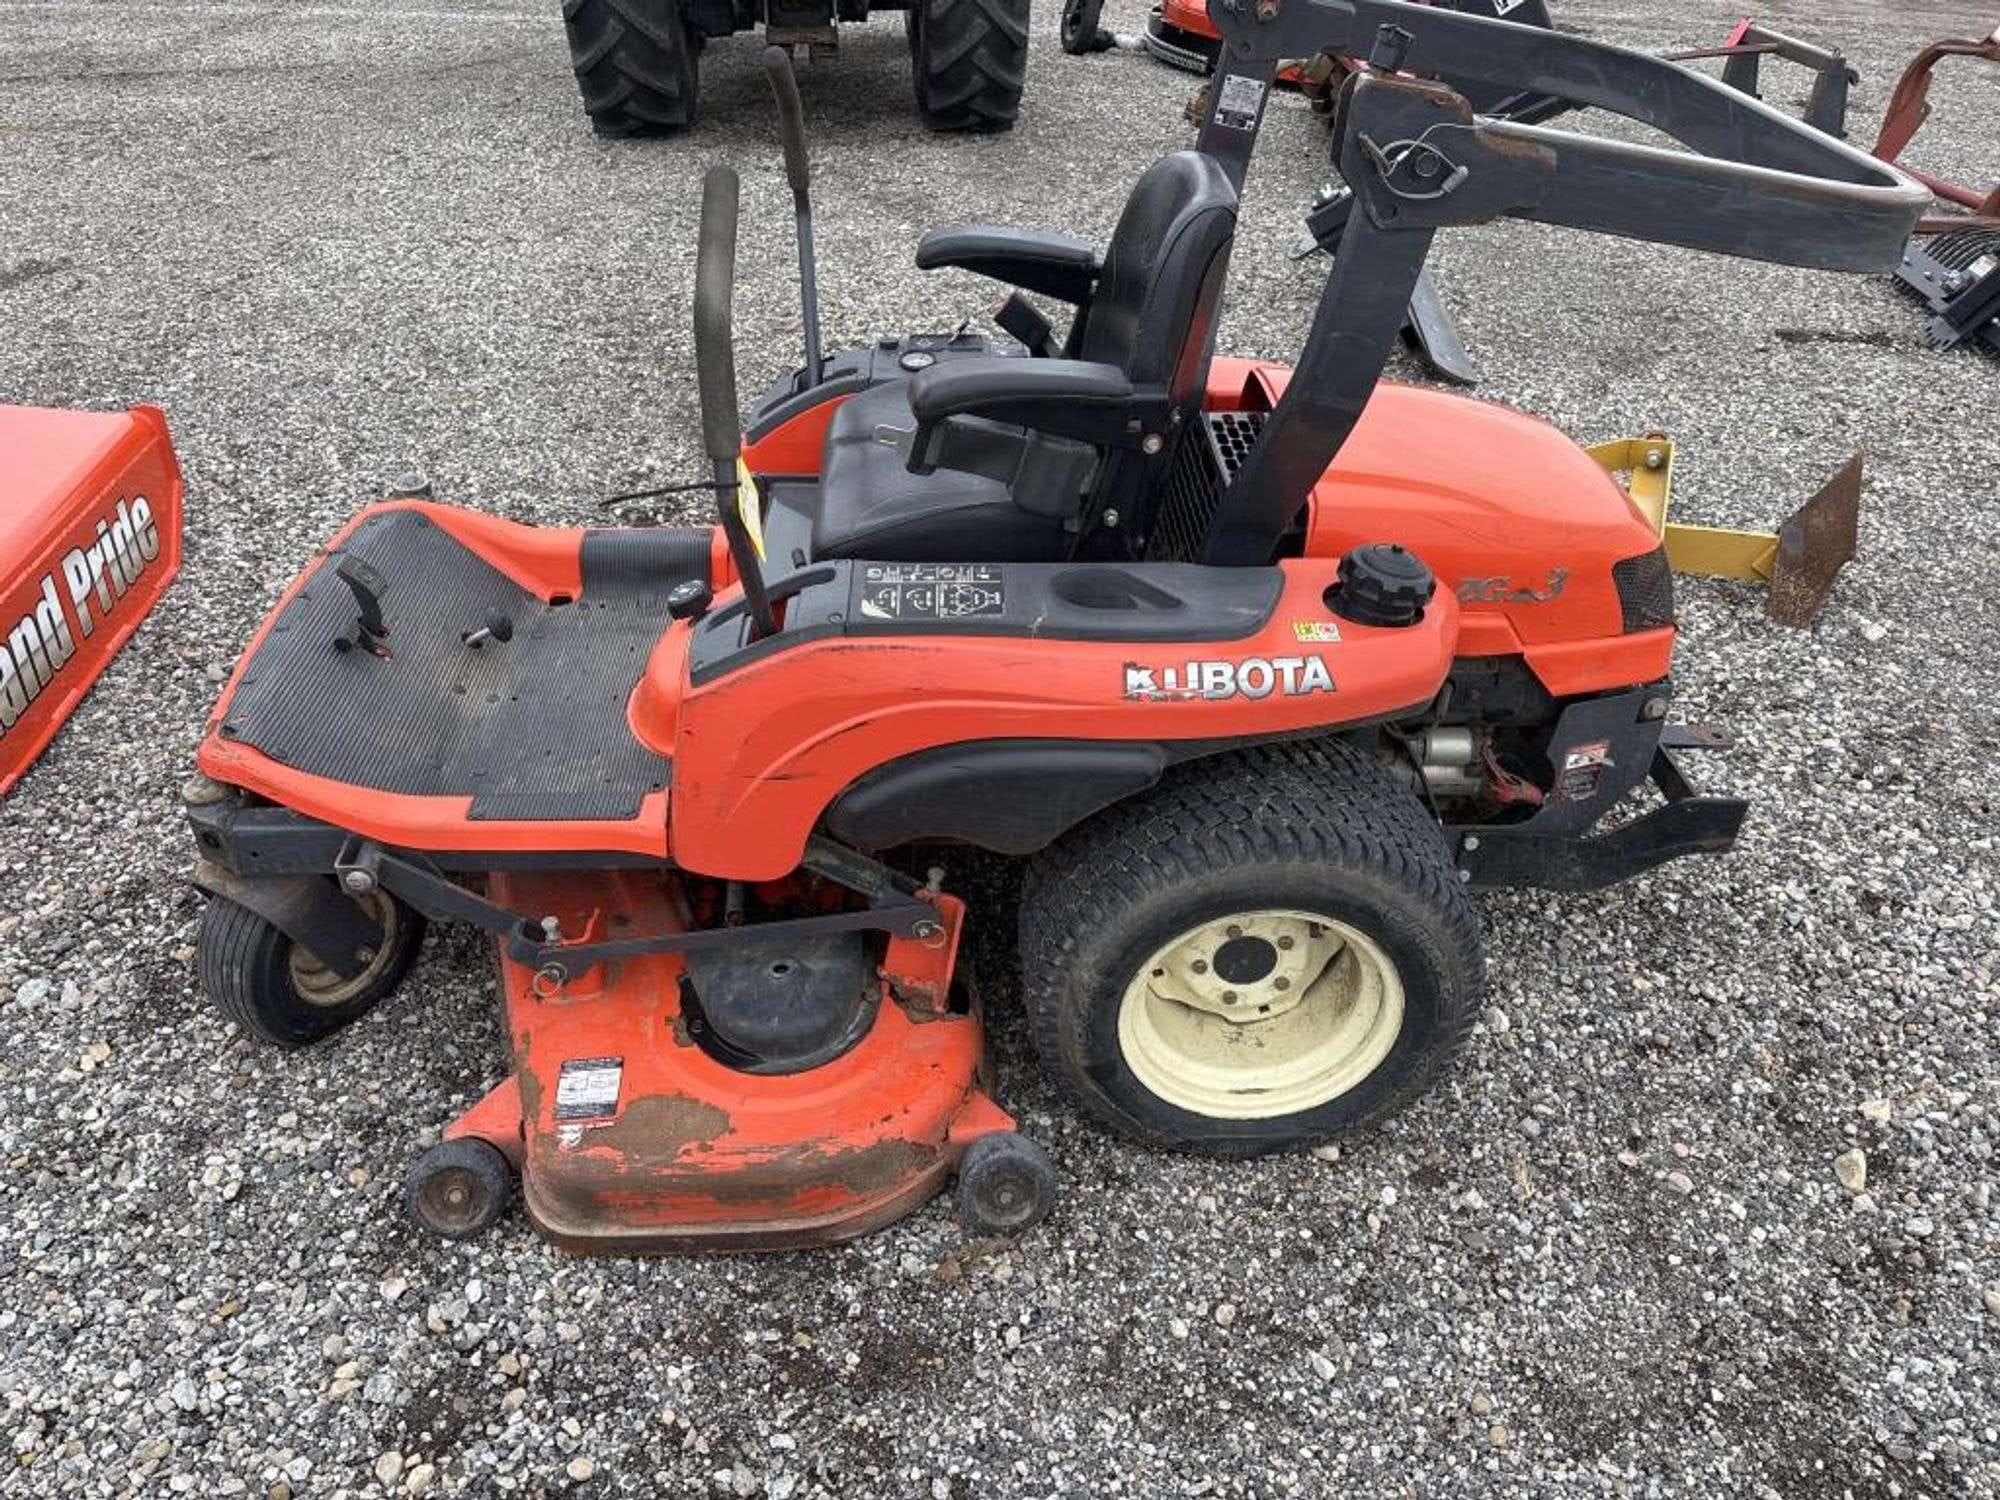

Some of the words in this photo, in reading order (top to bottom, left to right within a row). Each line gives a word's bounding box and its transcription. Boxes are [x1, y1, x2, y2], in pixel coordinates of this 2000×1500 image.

[0, 573, 75, 736] and
[61, 494, 160, 640] Pride
[1123, 654, 1337, 700] KUBOTA
